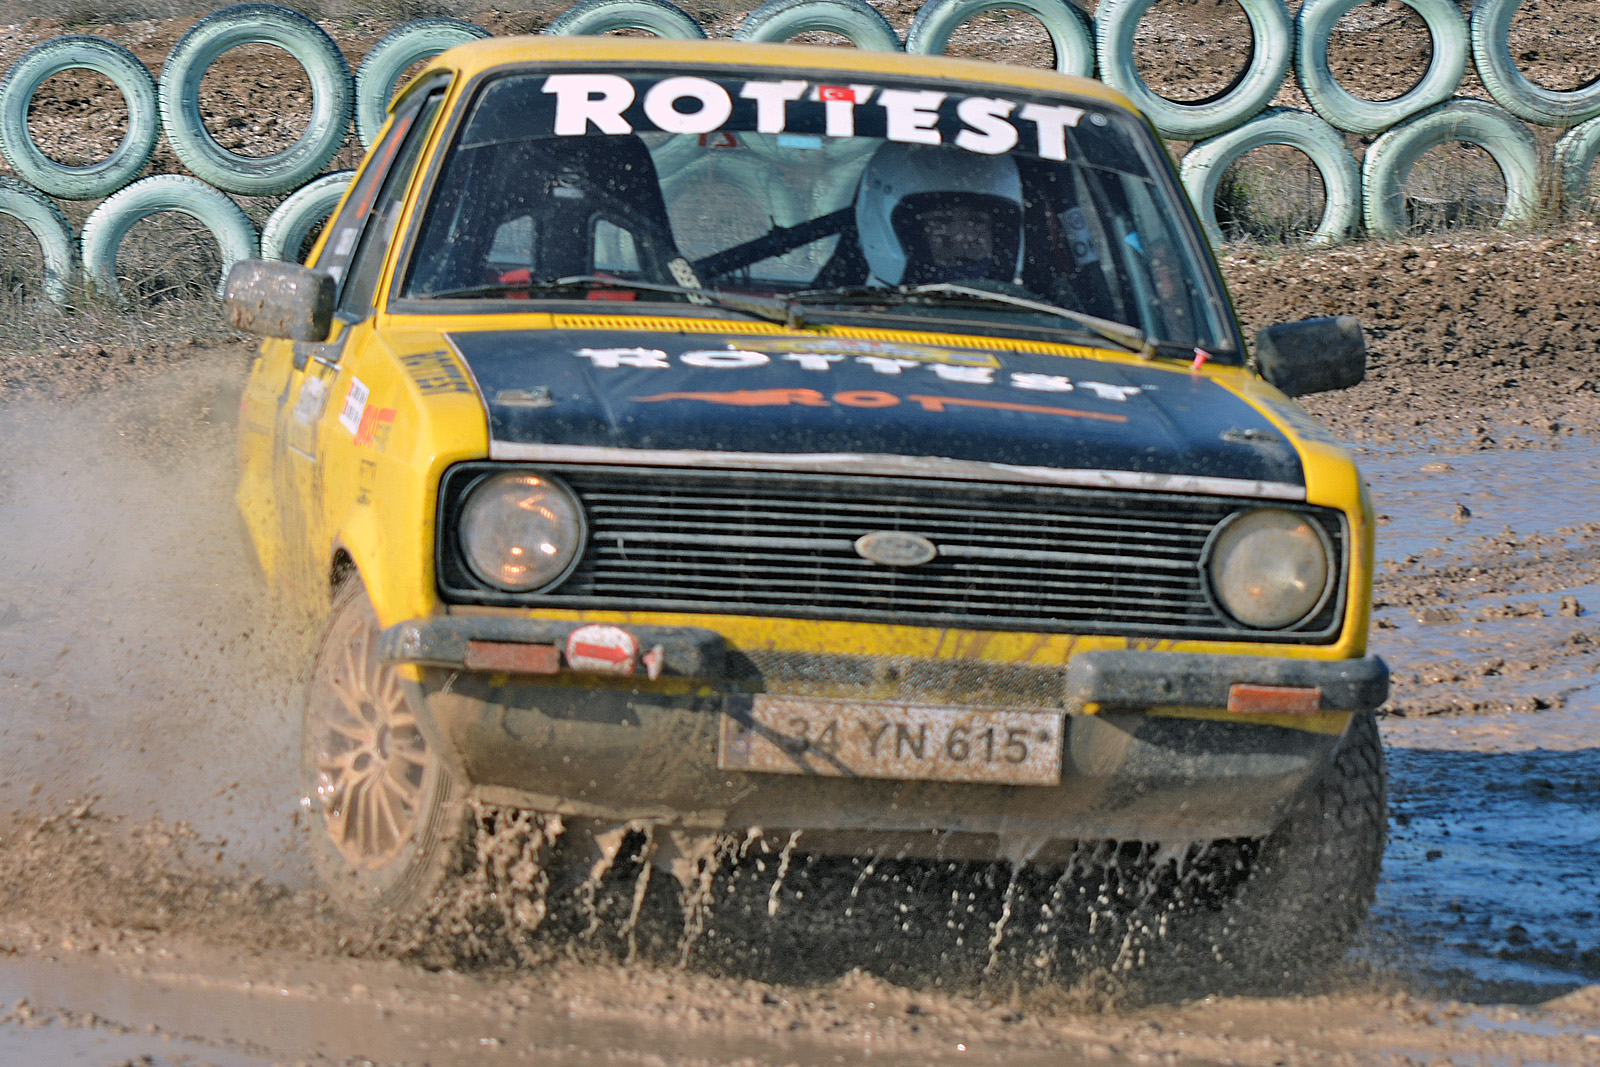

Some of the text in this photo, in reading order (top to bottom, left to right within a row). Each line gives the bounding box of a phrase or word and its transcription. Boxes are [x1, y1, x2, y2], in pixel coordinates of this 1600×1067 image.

[541, 73, 1084, 161] ROTTEST
[574, 346, 1141, 401] ROTTEST
[788, 717, 1031, 765] 34 YN 615
